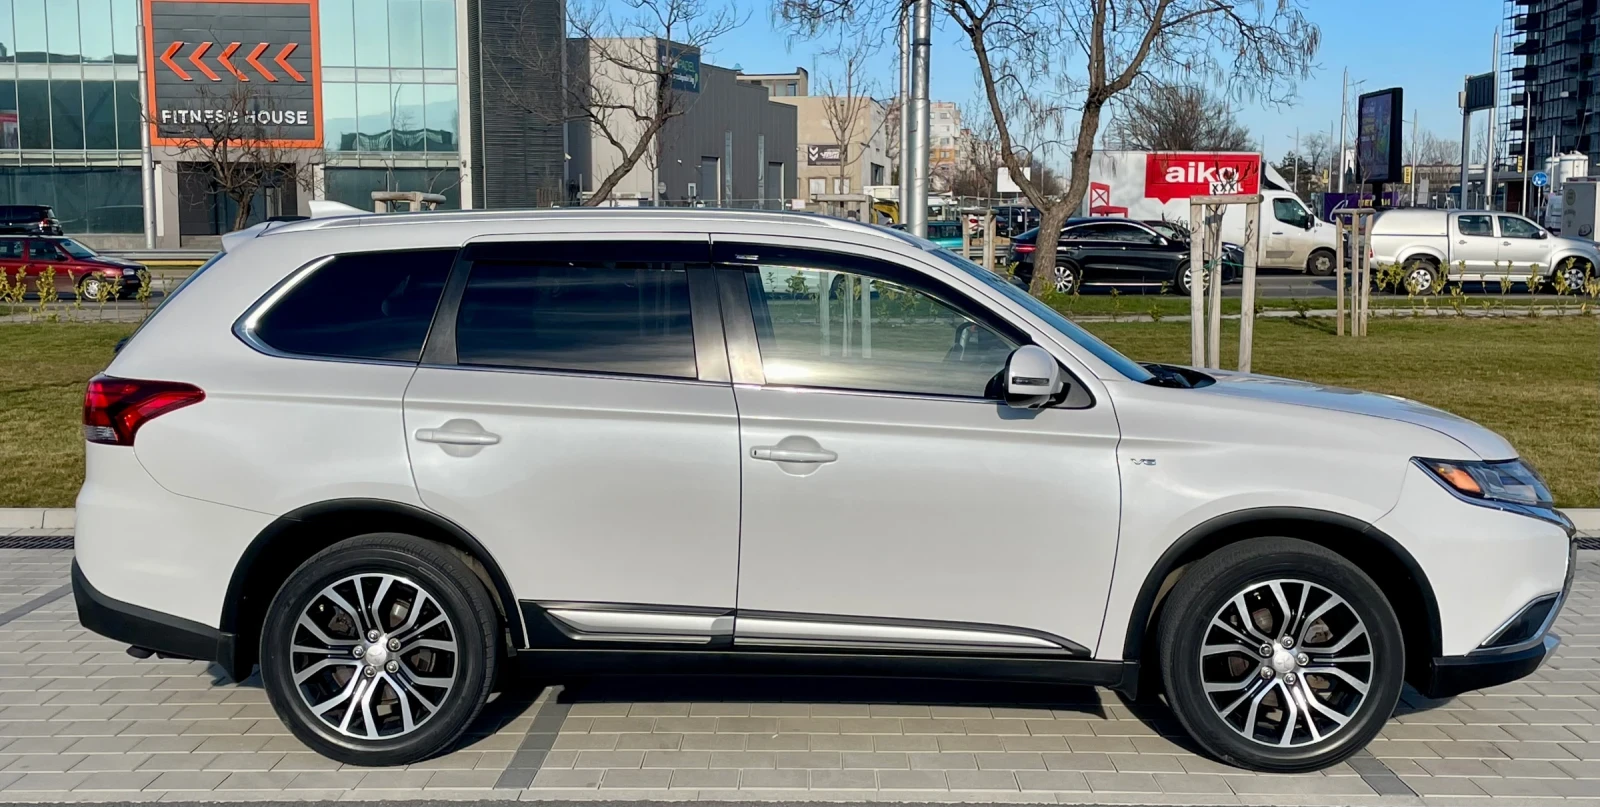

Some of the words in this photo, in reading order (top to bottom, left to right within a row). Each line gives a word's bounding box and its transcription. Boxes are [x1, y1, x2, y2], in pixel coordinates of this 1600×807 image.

[161, 109, 239, 124] FITNESS
[244, 110, 308, 125] HOUSE
[1165, 161, 1240, 184] aiko
